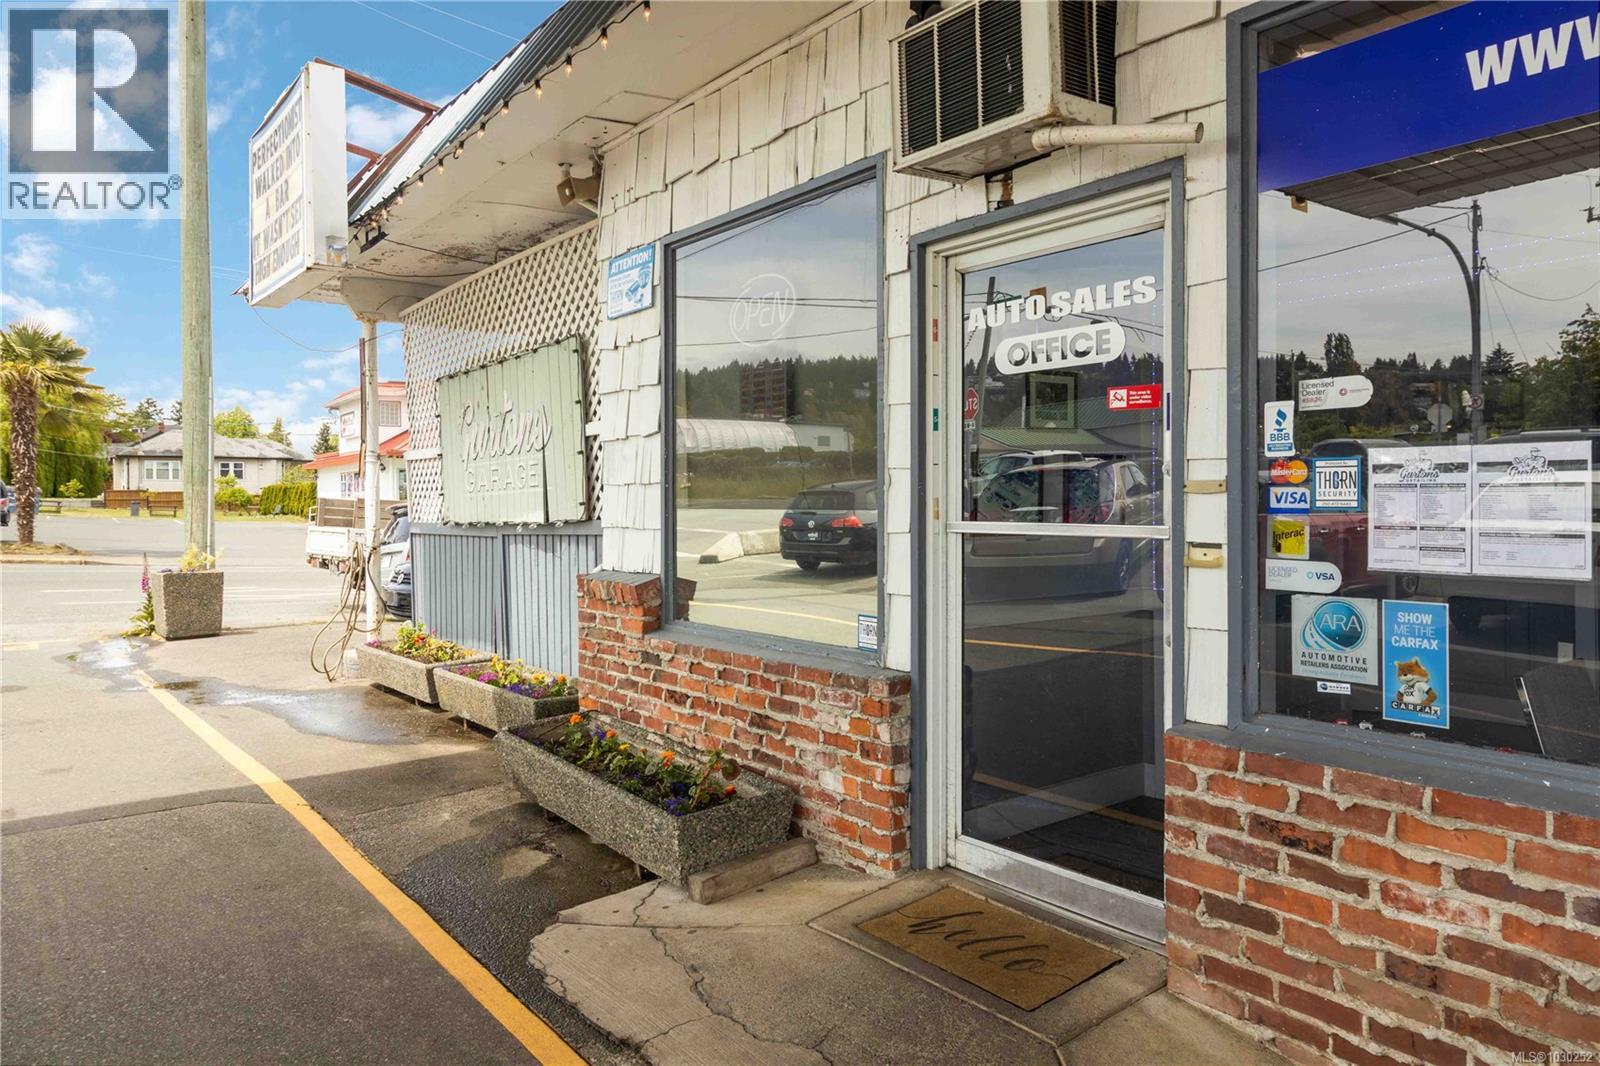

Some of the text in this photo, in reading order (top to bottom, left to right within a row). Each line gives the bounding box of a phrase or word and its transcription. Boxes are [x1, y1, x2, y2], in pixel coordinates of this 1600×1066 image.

[255, 153, 284, 199] WALKED
[276, 178, 289, 212] BAR
[271, 229, 300, 273] ENOUGH
[610, 248, 652, 275] ATTENTION!
[733, 287, 790, 332] OPEN
[967, 275, 1158, 332] AUTO SALES
[1007, 328, 1111, 367] OFFICE
[1301, 381, 1334, 390] Licensed
[1301, 389, 1327, 397] Dealer
[1269, 433, 1290, 442] BBB
[464, 463, 540, 494] GARAGE
[1317, 470, 1357, 490] THORN
[1274, 491, 1308, 505] VISA
[1317, 490, 1357, 498] SECURITY
[1272, 529, 1305, 541] Interac
[1315, 572, 1335, 580] VSA
[1319, 613, 1362, 633] ARA
[1396, 611, 1433, 625] SHOW
[1393, 624, 1436, 638] ME THE
[1391, 636, 1439, 650] CARFAX
[1301, 652, 1368, 665] AUTOMOTIVE
[1301, 660, 1369, 674] RETAILERS ASSOCIATION
[1391, 701, 1440, 716] CARFAX
[897, 909, 1075, 983] hello
